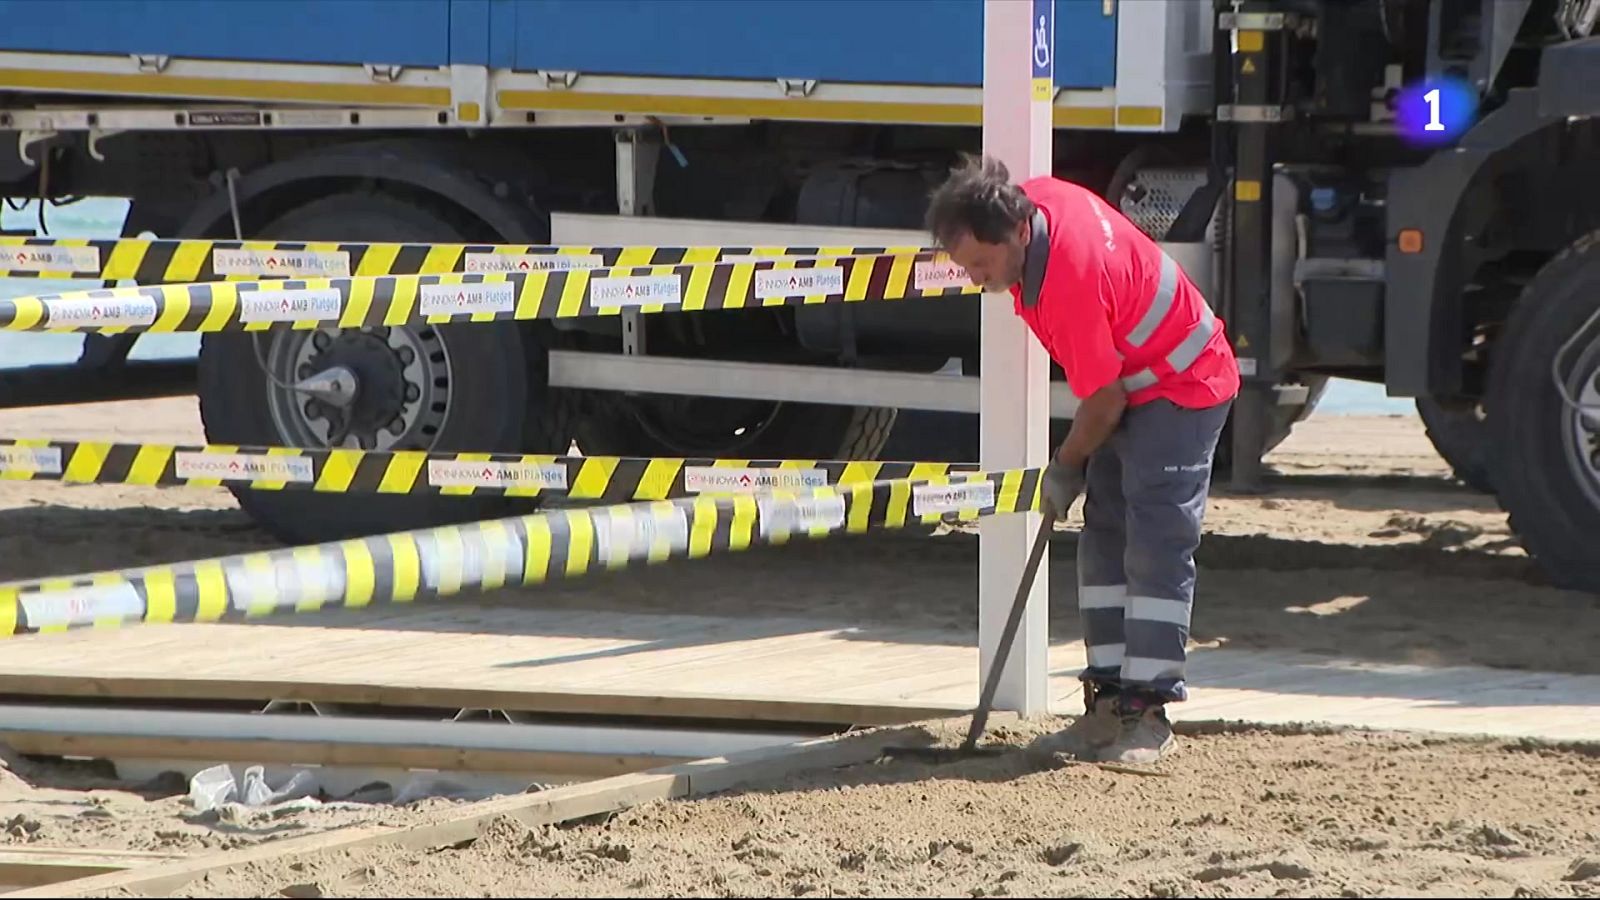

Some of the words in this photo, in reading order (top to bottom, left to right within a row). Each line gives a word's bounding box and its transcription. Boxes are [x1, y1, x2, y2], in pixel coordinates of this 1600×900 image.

[279, 258, 302, 269] AMB
[532, 261, 555, 270] AMB
[798, 276, 813, 288] AMB
[634, 285, 650, 297] AMB
[466, 292, 483, 304] AMB
[242, 463, 265, 473] AMB
[496, 470, 519, 480] AMB
[754, 476, 778, 487] AMB
